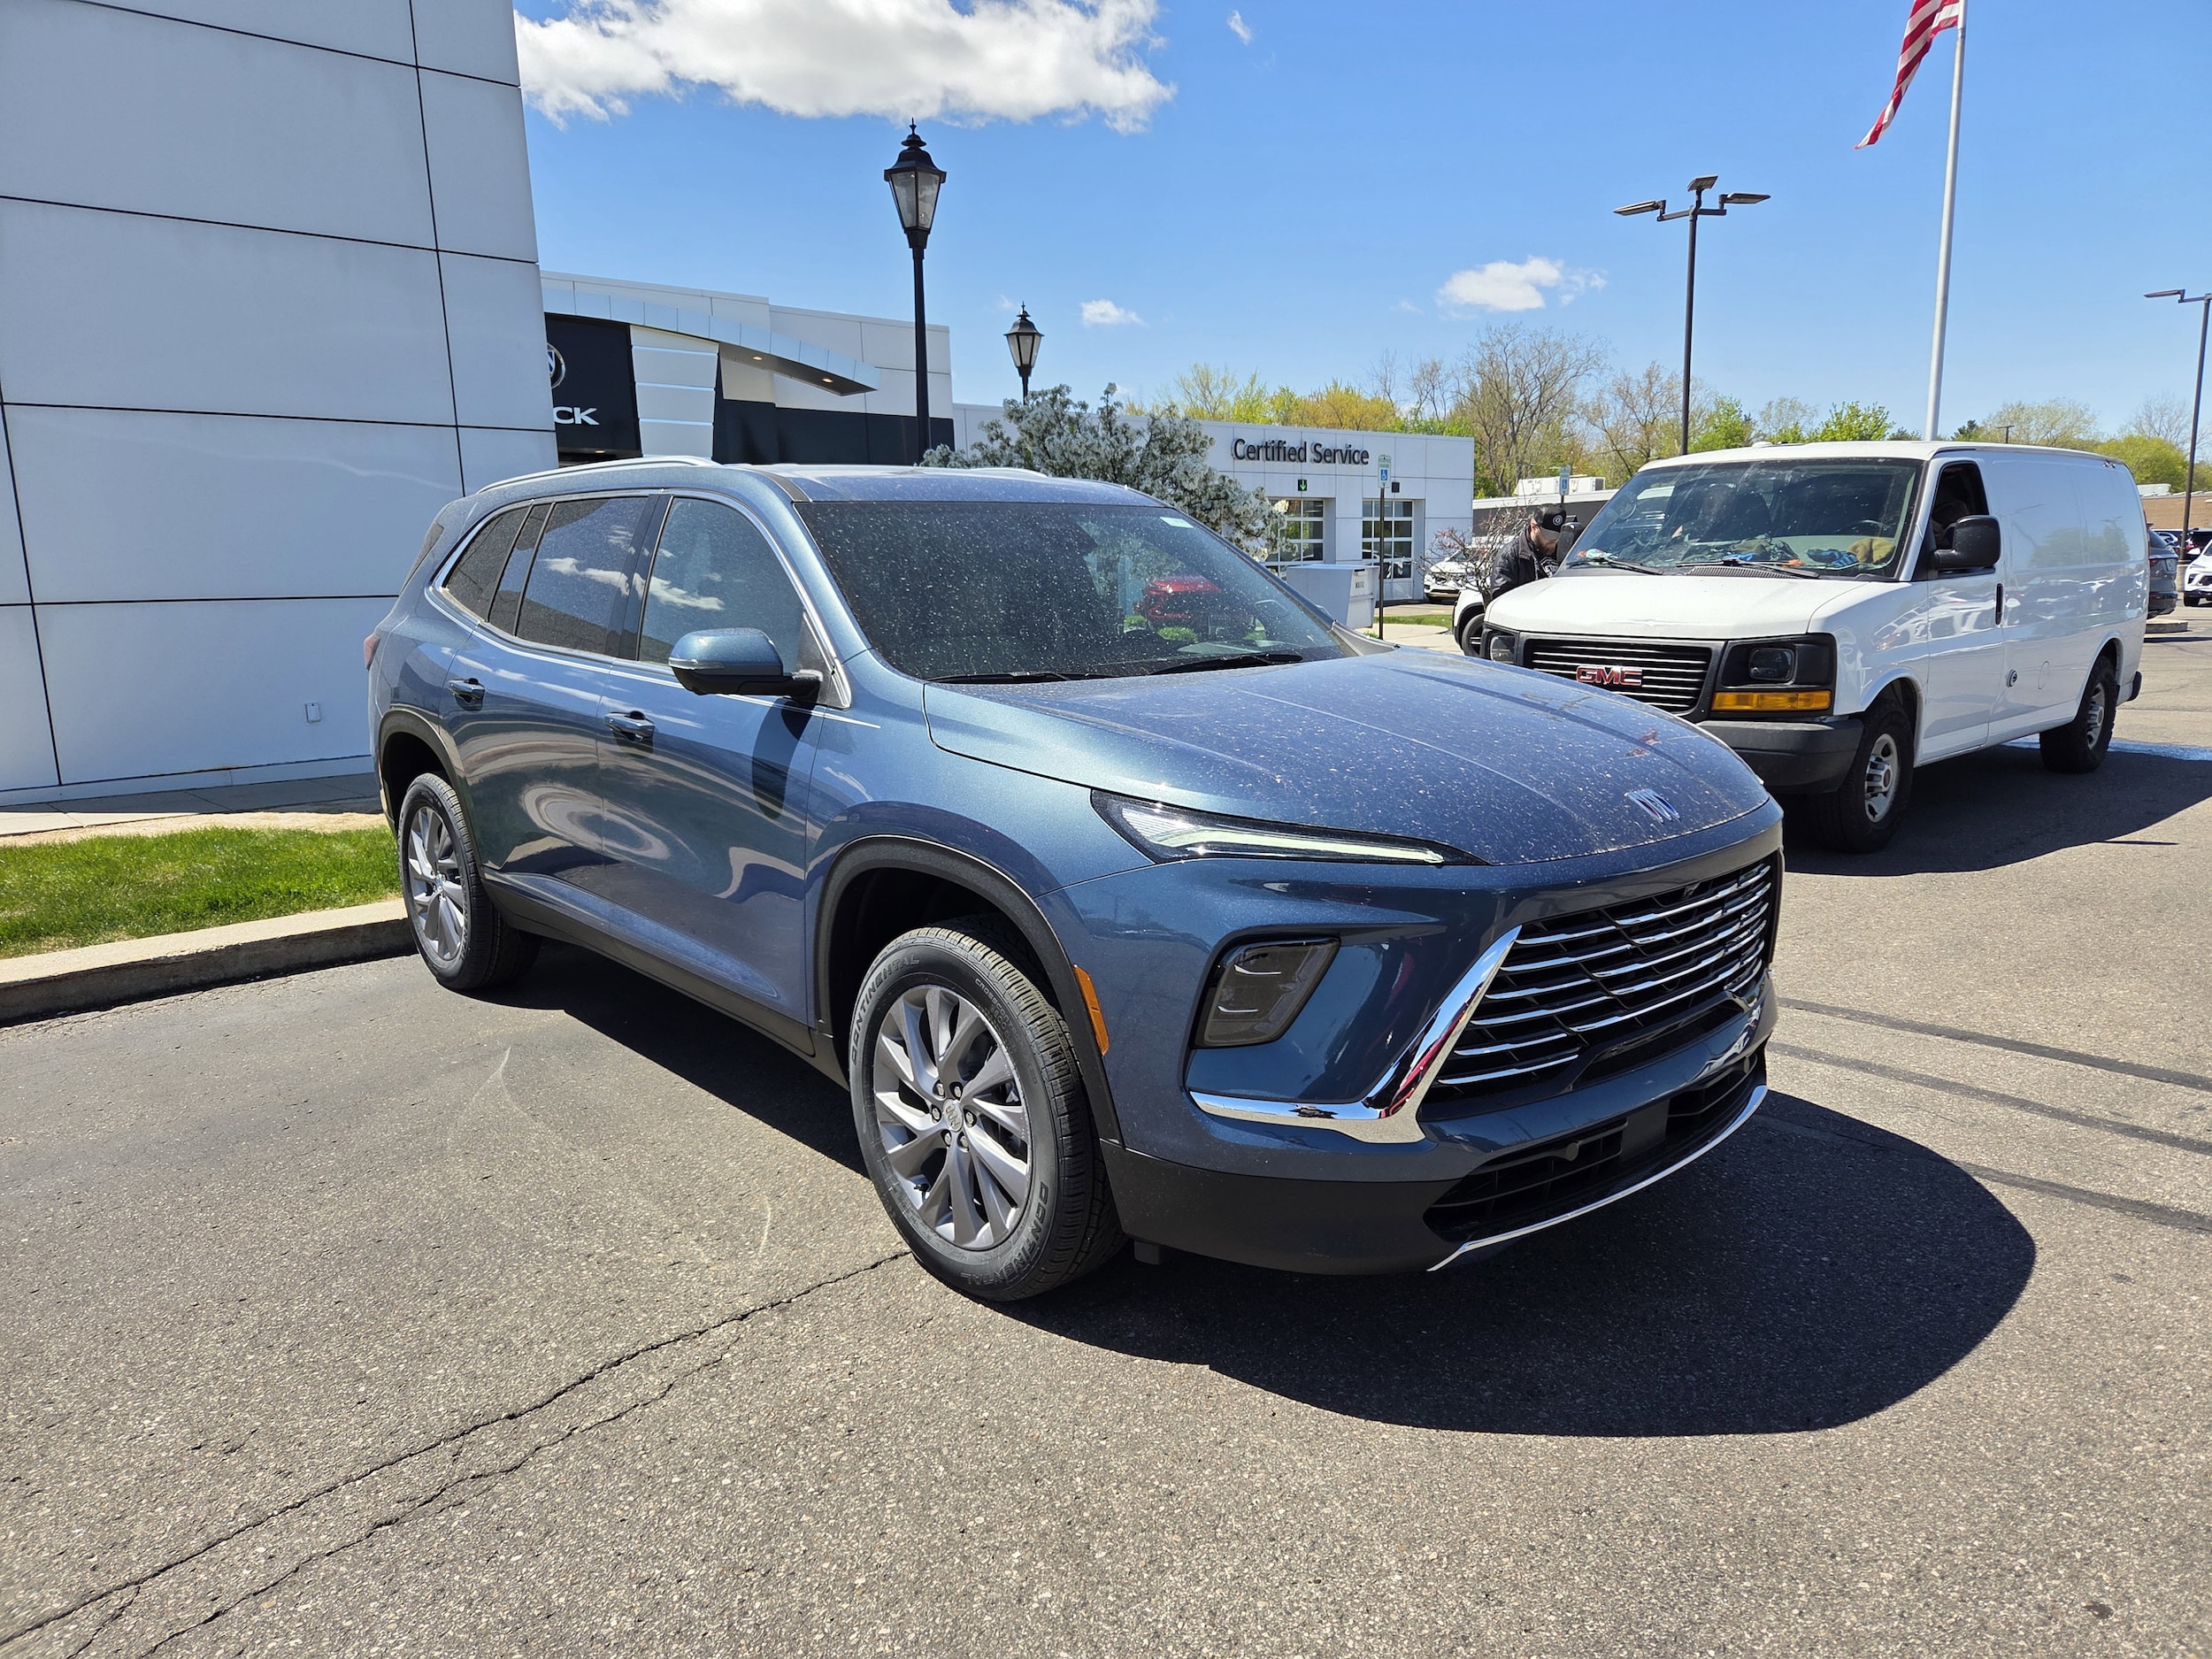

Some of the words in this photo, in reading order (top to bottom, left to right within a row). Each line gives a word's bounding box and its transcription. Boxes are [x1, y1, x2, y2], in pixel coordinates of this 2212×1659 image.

[553, 406, 600, 426] CK
[1233, 438, 1307, 463] Certified
[1312, 442, 1370, 465] Service
[1576, 665, 1642, 686] GMC
[851, 954, 920, 1066] CONTINENTAL
[960, 1181, 1049, 1286] CONTINENTAL
